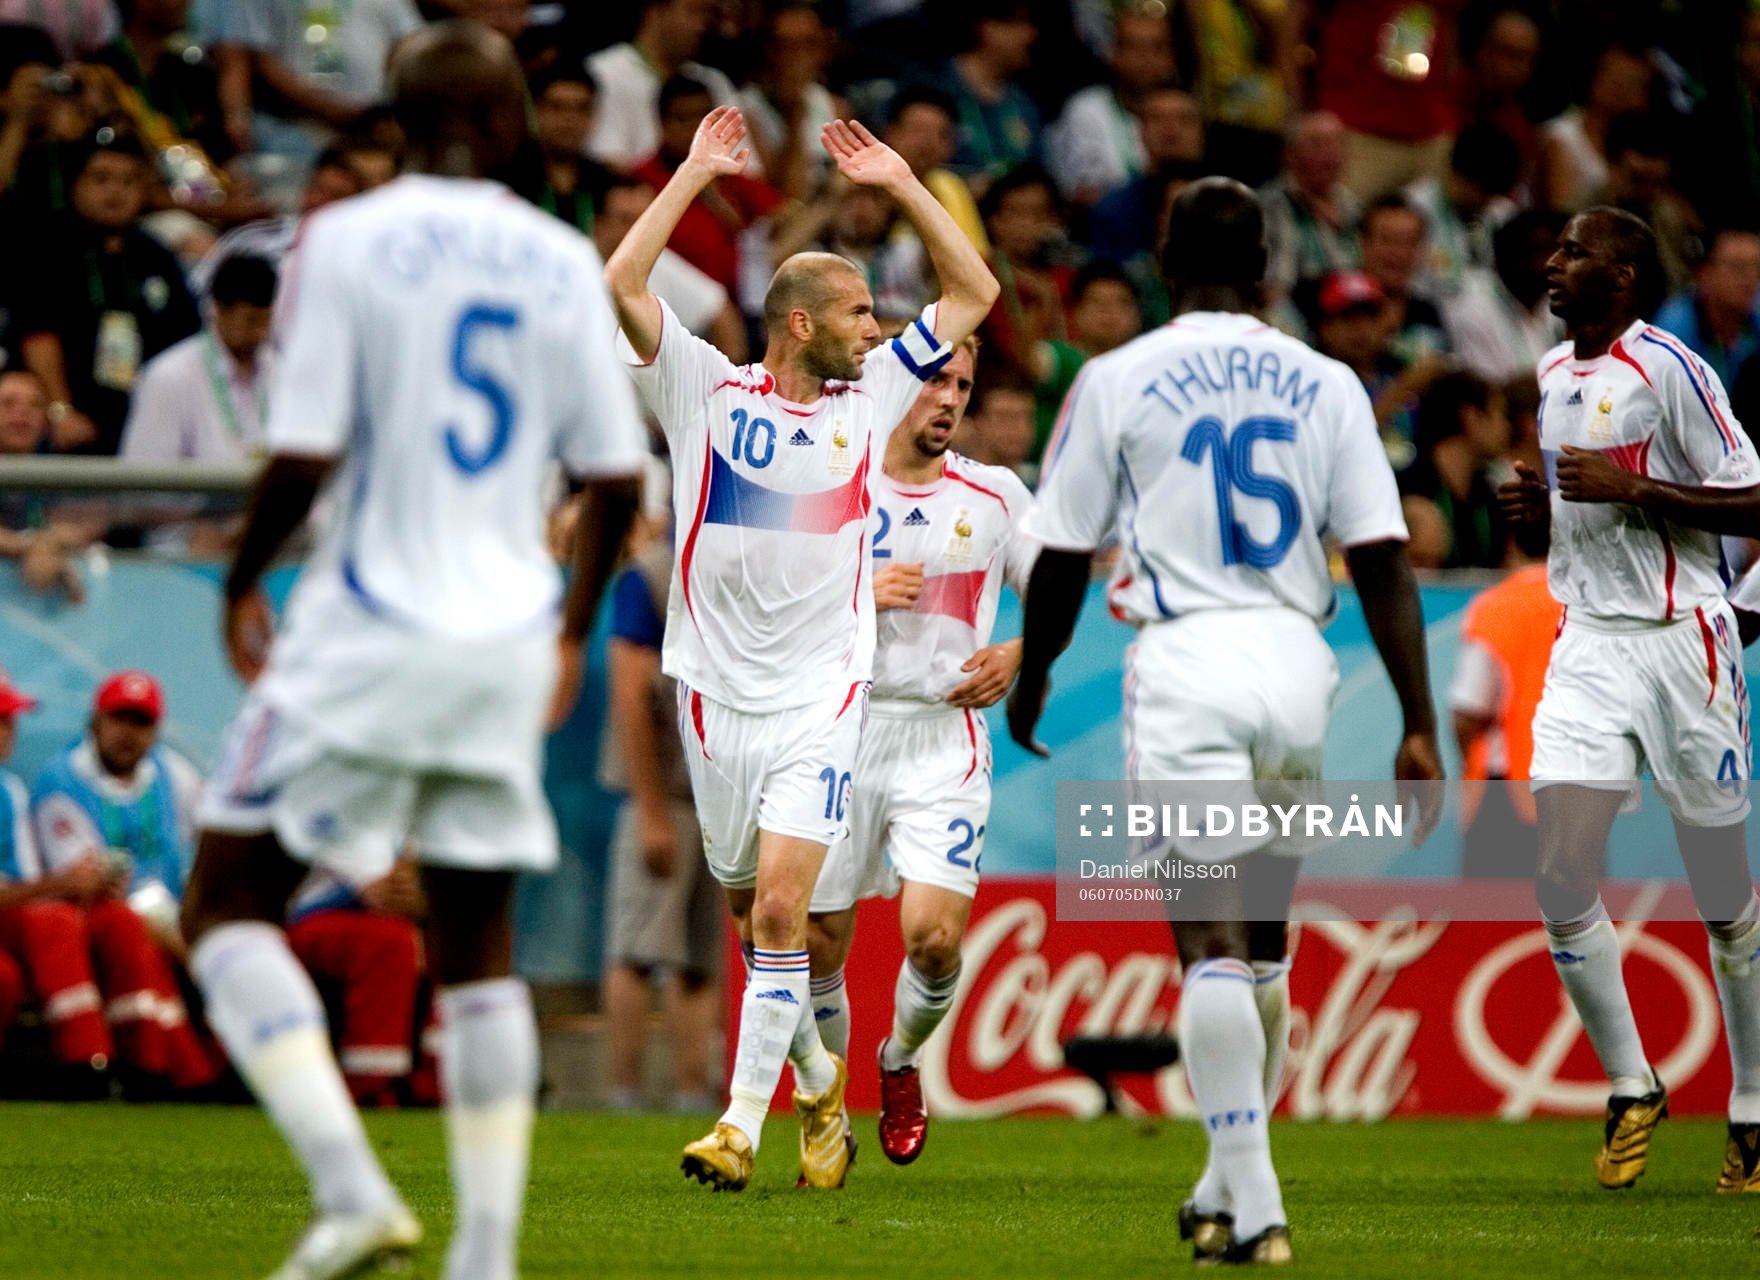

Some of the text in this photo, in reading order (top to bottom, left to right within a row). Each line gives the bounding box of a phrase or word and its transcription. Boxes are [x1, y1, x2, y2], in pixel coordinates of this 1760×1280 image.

[442, 301, 520, 475] 5
[1142, 345, 1321, 418] THURAM
[730, 407, 777, 469] 10
[1180, 414, 1303, 570] 15
[1716, 748, 1743, 797] 4
